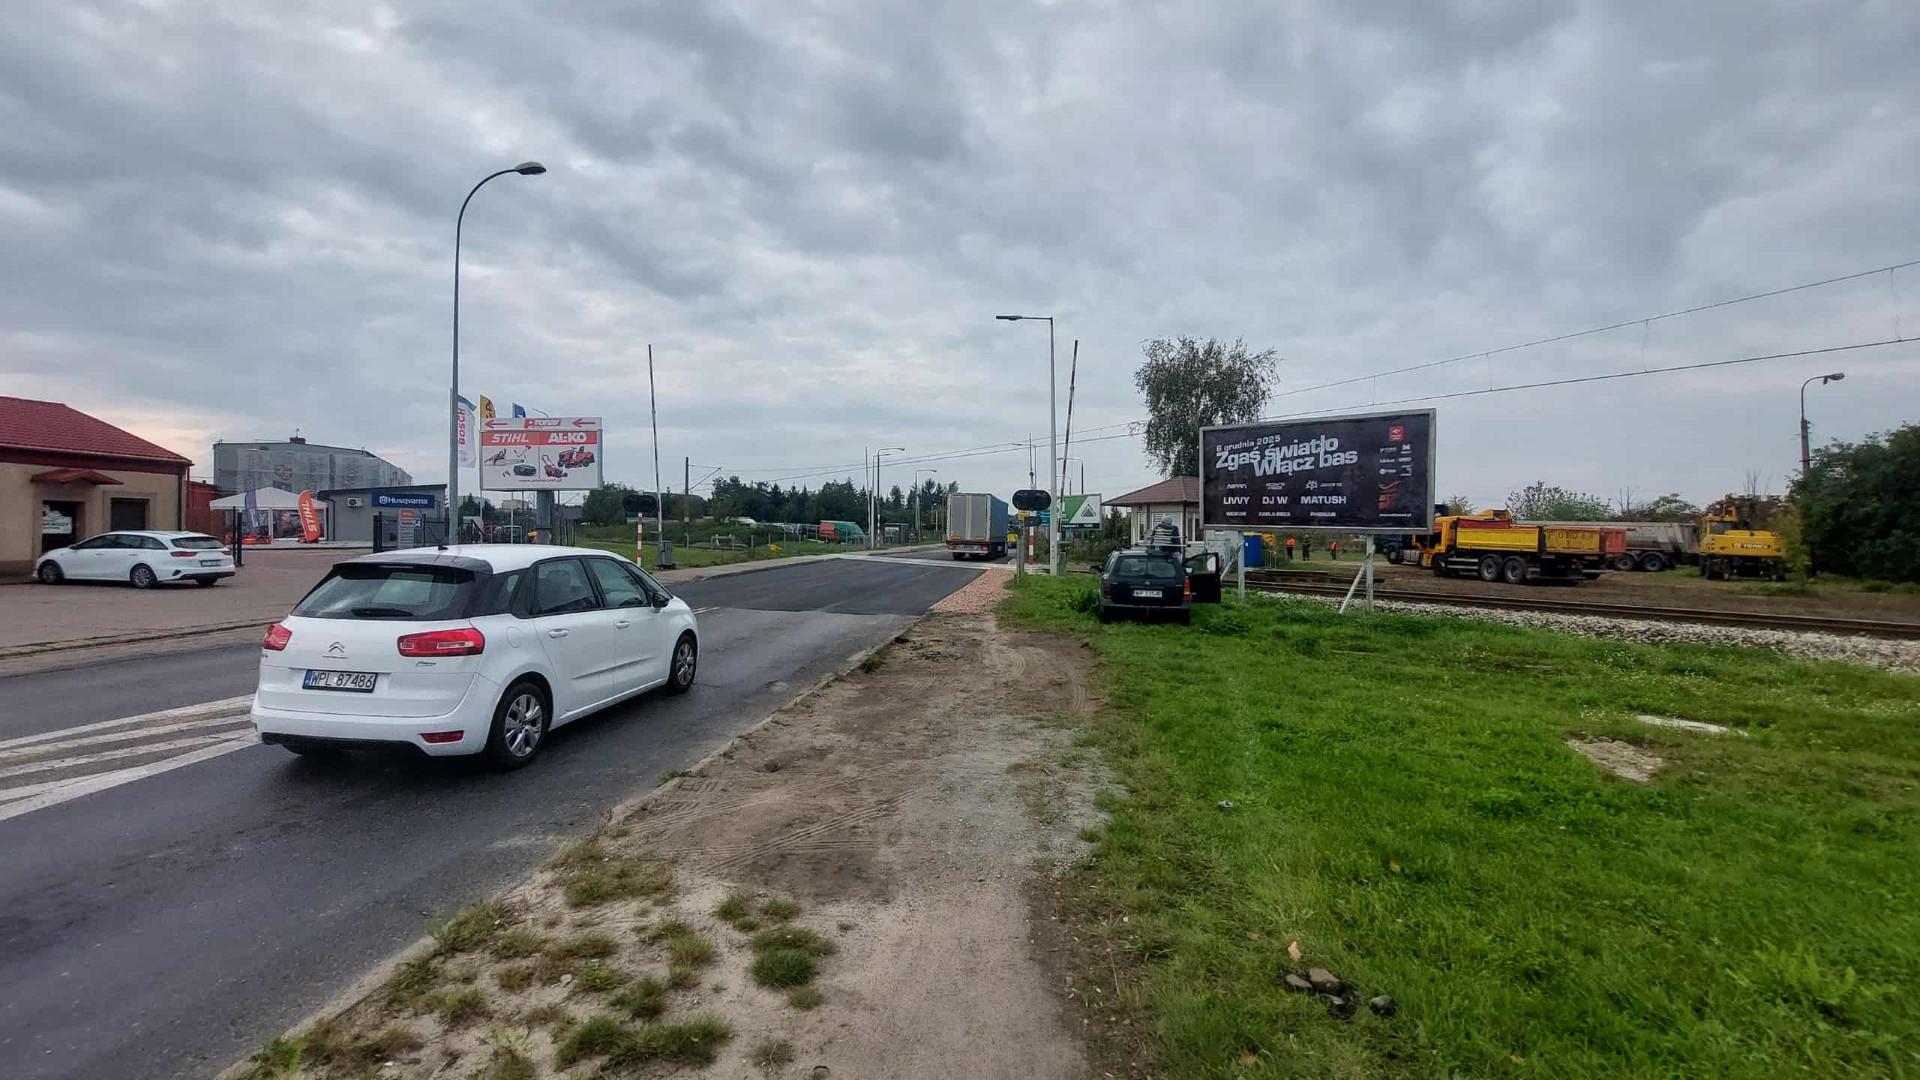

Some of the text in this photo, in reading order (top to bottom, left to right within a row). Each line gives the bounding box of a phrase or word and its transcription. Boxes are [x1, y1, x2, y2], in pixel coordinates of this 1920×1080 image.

[491, 433, 529, 443] STIHL
[1224, 440, 1255, 452] grudnia
[1256, 434, 1281, 445] 2025
[1216, 434, 1339, 471] Zgaś światło
[1252, 448, 1359, 477] Włącz bas
[388, 496, 428, 505] Husqvarna
[1262, 496, 1288, 505] DJ W
[1301, 495, 1347, 505] MATUSH
[301, 499, 317, 532] STIHL
[311, 672, 373, 688] WPL 87486
